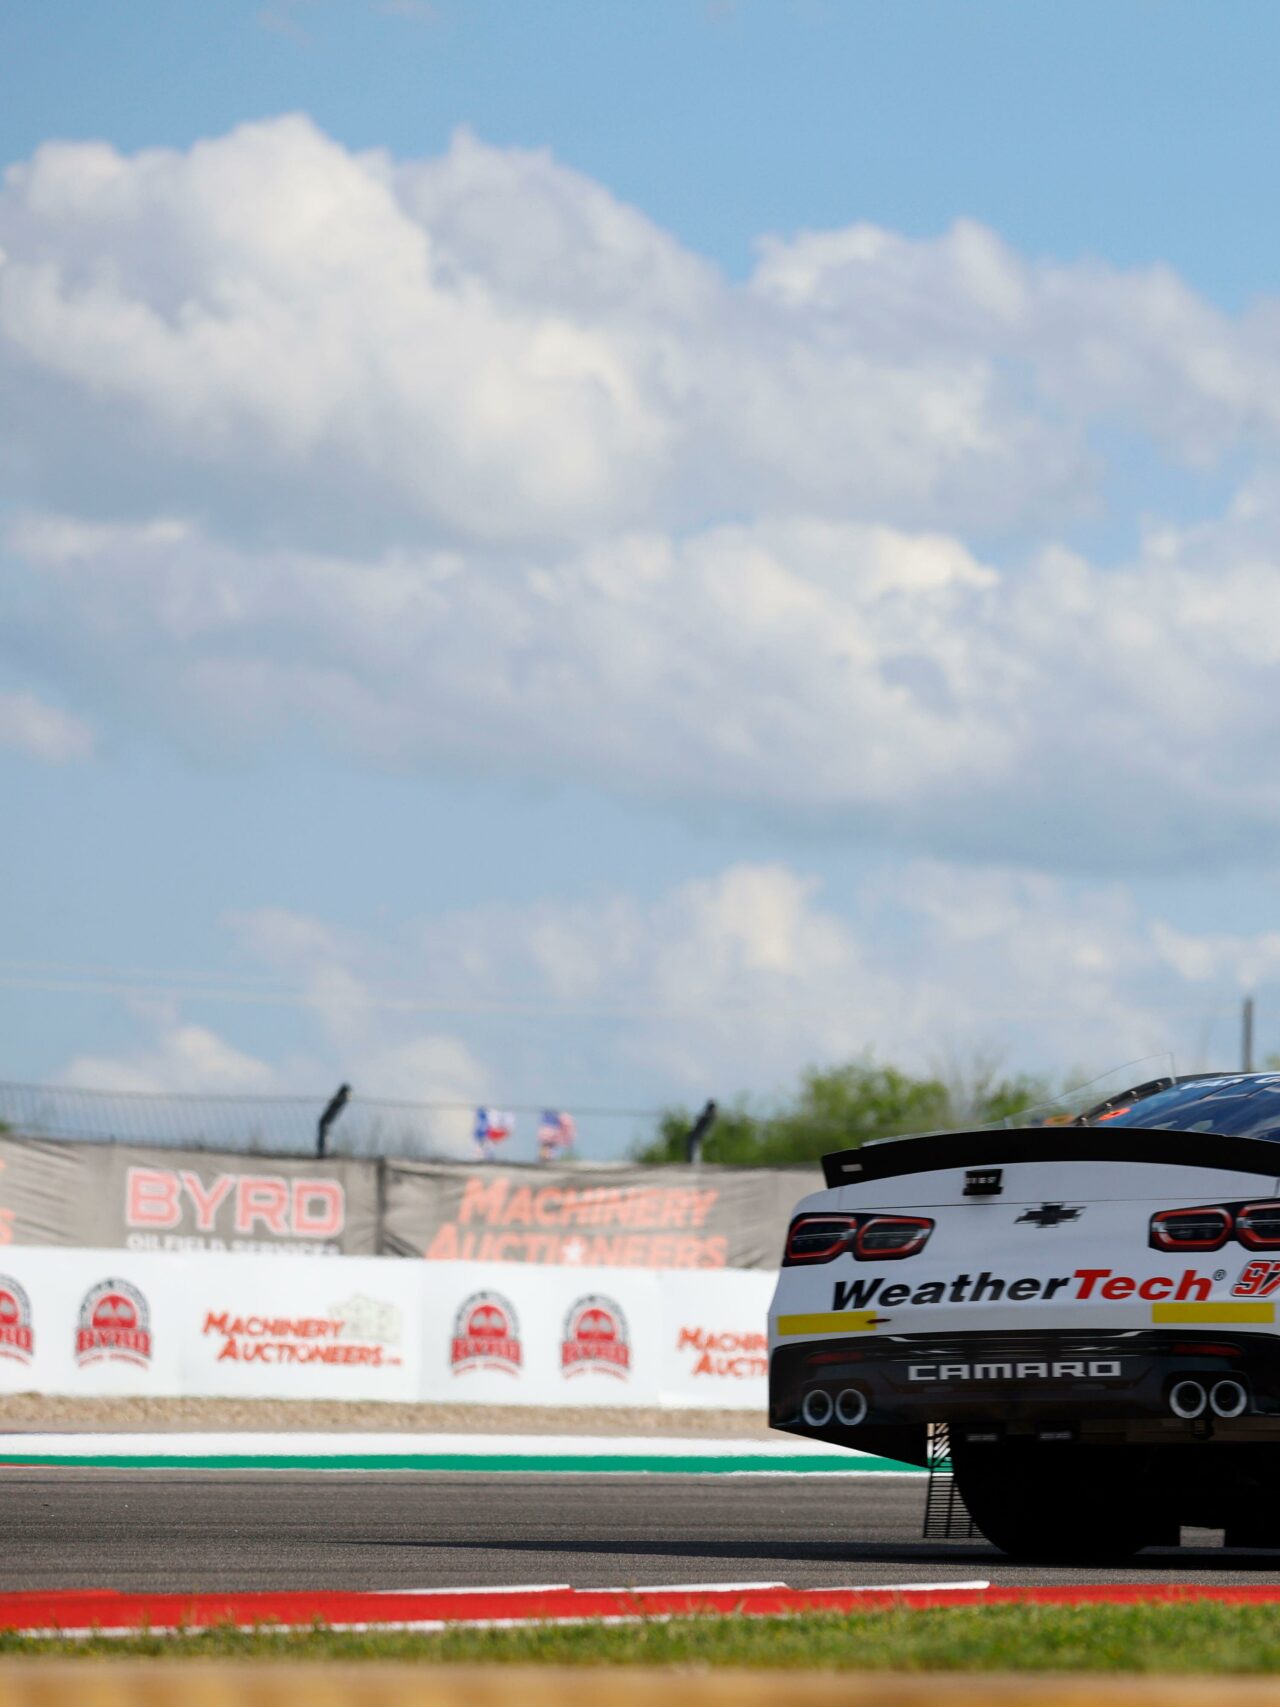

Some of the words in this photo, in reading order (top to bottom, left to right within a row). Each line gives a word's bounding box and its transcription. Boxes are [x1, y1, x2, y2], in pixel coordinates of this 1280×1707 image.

[126, 1166, 346, 1237] BYRD
[457, 1174, 720, 1227] MACHINERY
[424, 1221, 729, 1269] AUCTIONEERS
[202, 1311, 346, 1338] MACHINERY
[216, 1336, 385, 1368] AUCTIONEERS
[908, 1360, 1122, 1382] CAMARO
